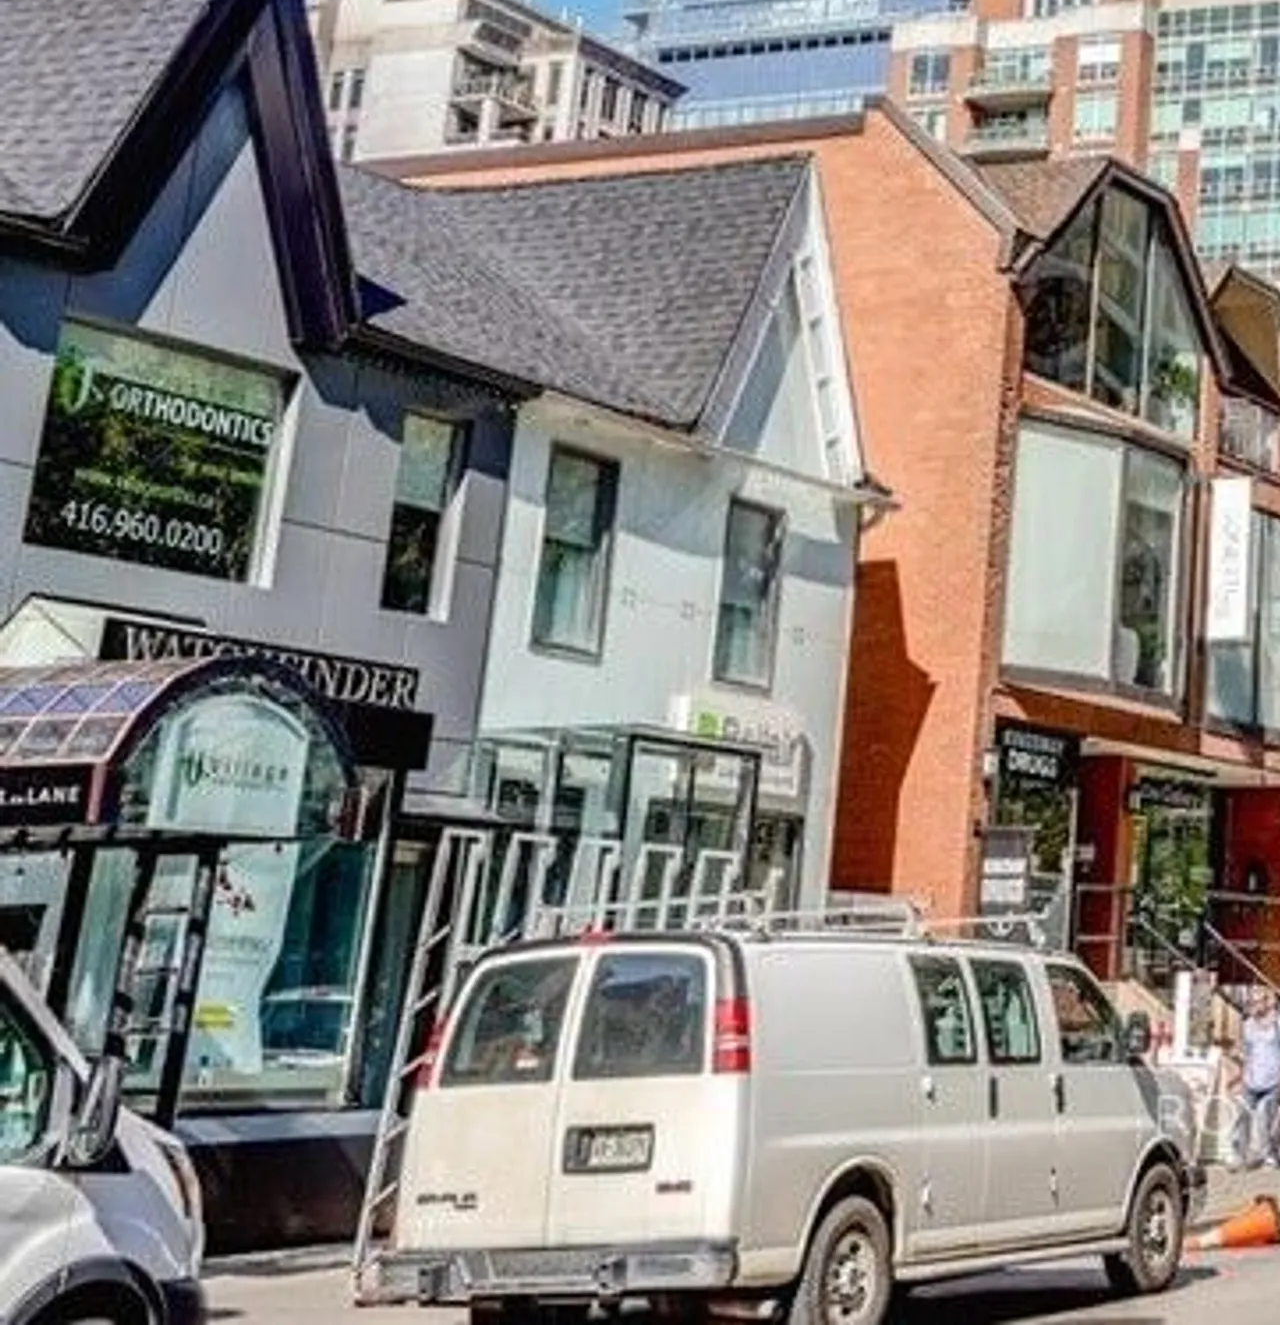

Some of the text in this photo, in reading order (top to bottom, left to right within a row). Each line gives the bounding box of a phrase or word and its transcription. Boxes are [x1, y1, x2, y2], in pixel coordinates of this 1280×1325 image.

[109, 382, 273, 446] ORTHODONTICS
[60, 499, 222, 555] 416.960.0200
[125, 625, 415, 710] WATINDER
